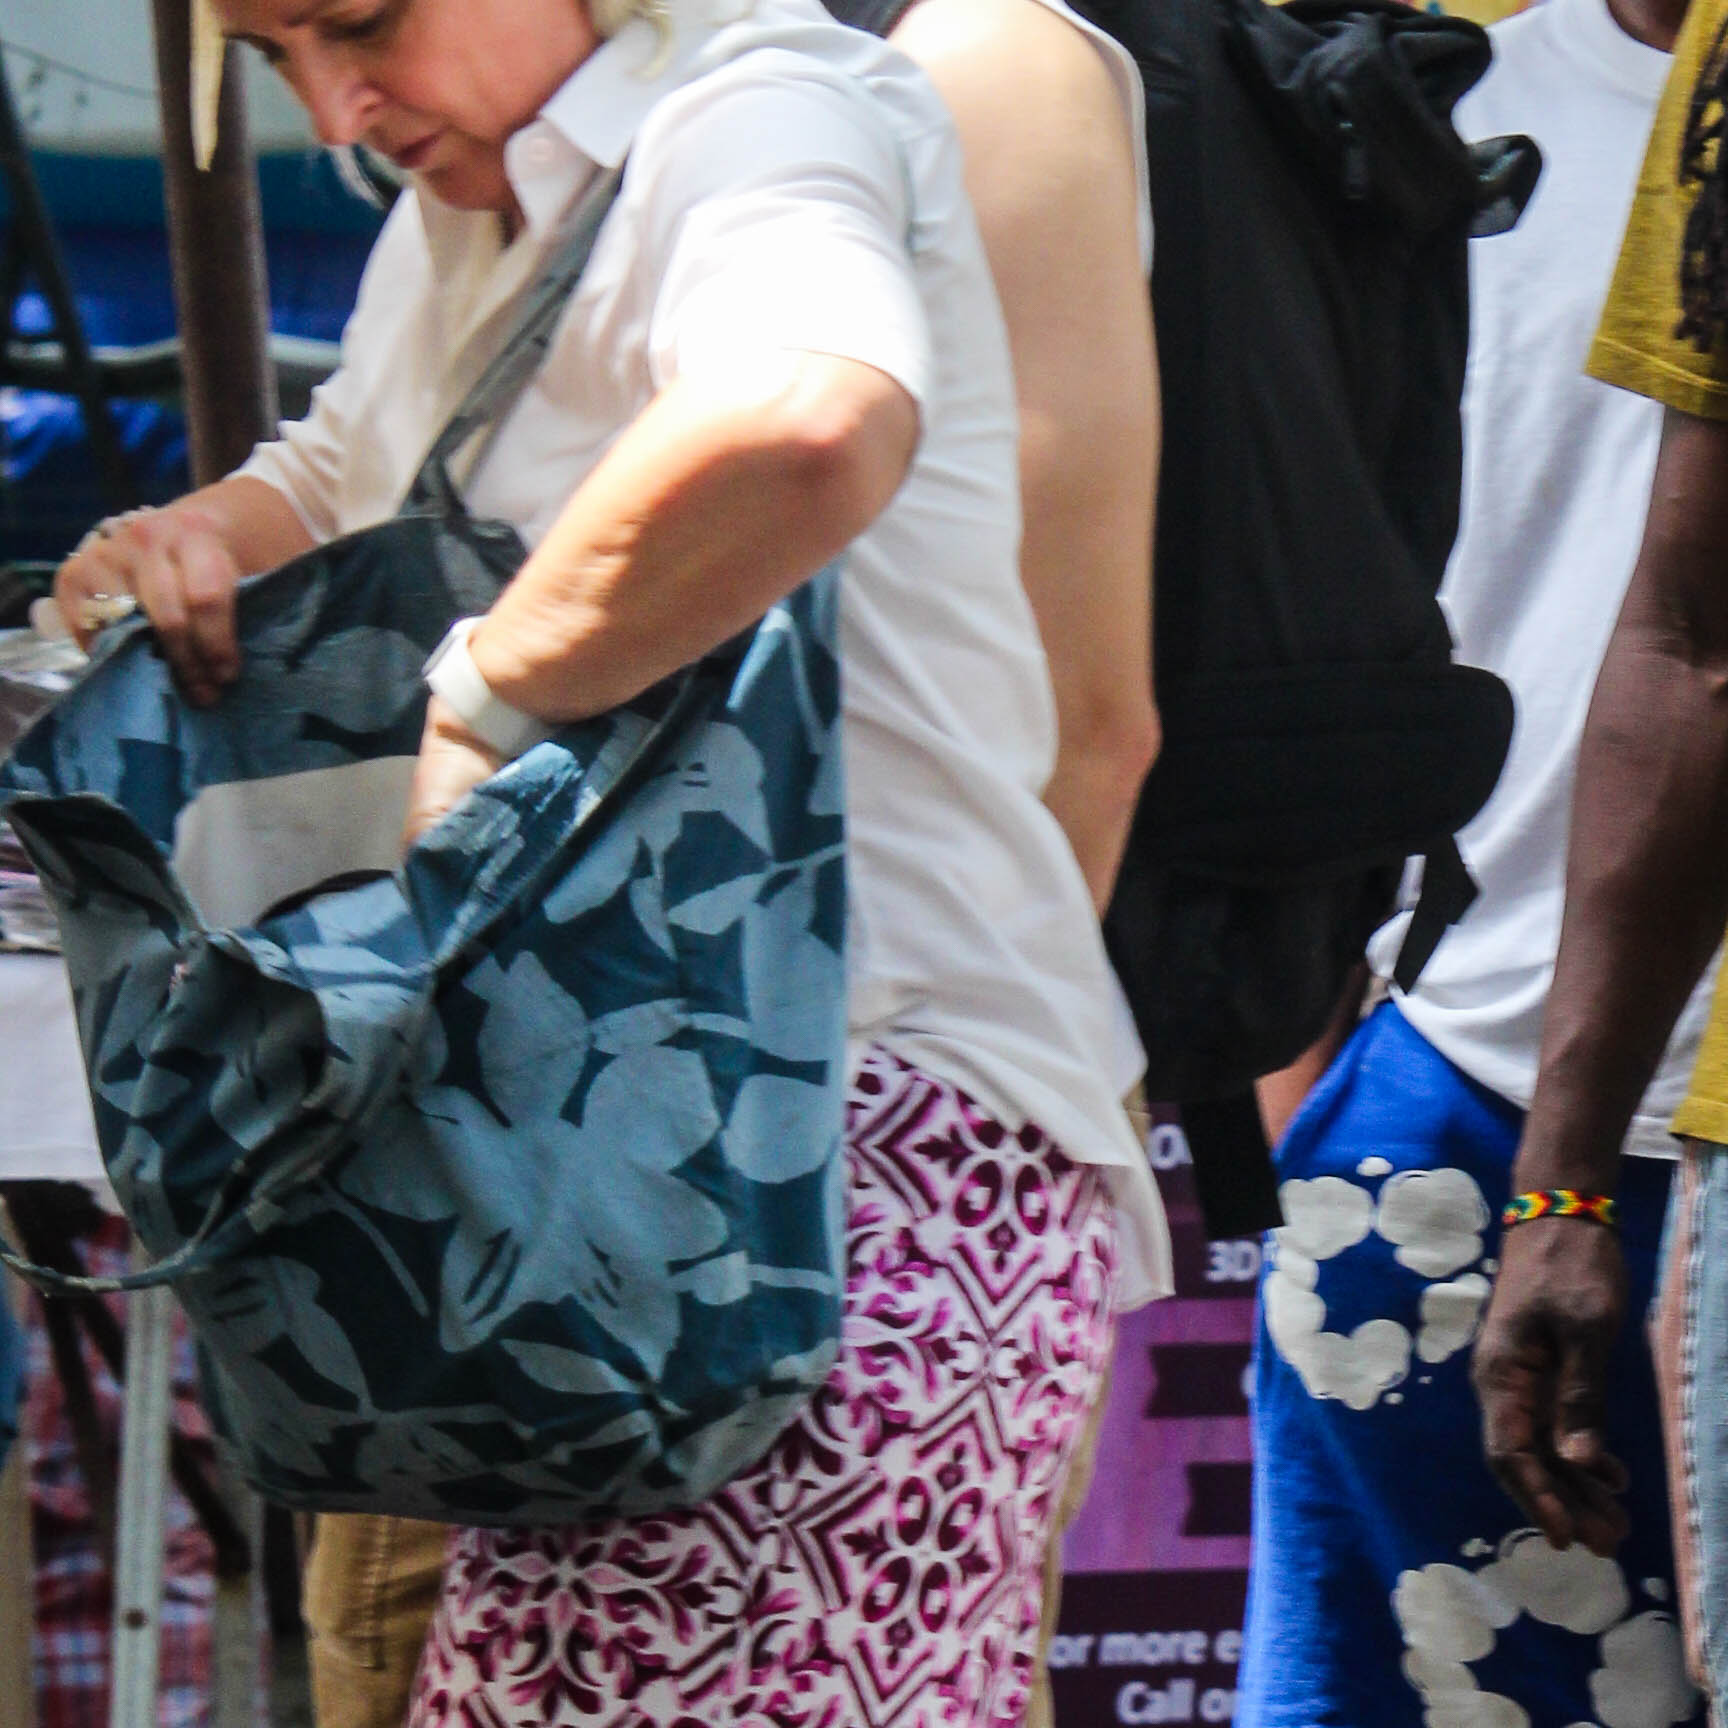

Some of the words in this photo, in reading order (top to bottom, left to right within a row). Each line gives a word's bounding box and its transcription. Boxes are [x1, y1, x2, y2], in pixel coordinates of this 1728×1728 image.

[1046, 1634, 1095, 1669] or
[1099, 1631, 1208, 1666] more
[1116, 1677, 1196, 1725] Call
